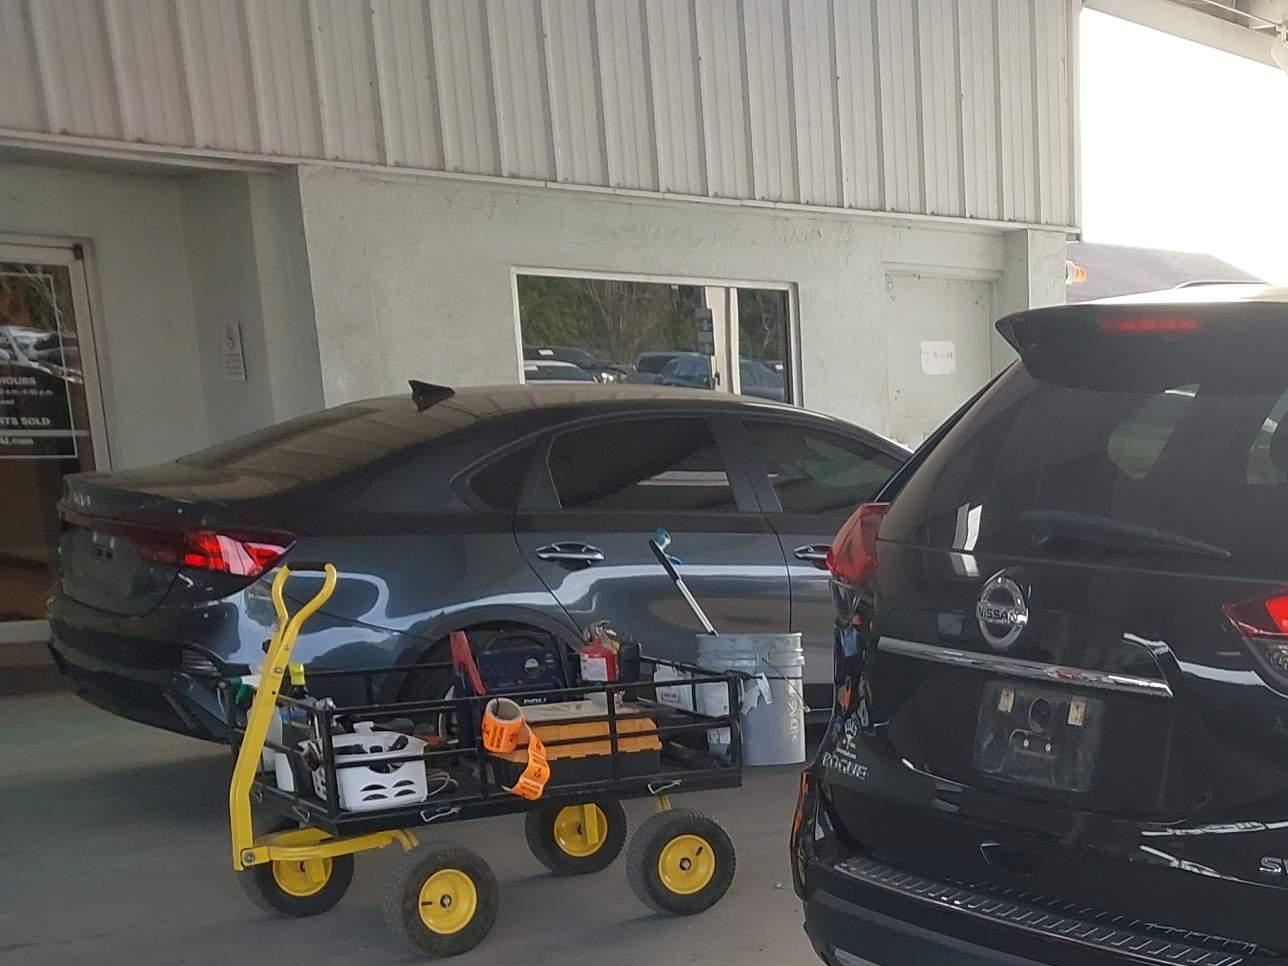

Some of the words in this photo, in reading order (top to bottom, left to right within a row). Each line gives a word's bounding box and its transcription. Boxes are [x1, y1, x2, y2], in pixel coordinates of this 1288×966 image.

[20, 416, 50, 426] SOLD
[977, 602, 1018, 624] NISSAN
[822, 751, 868, 780] ROGUE
